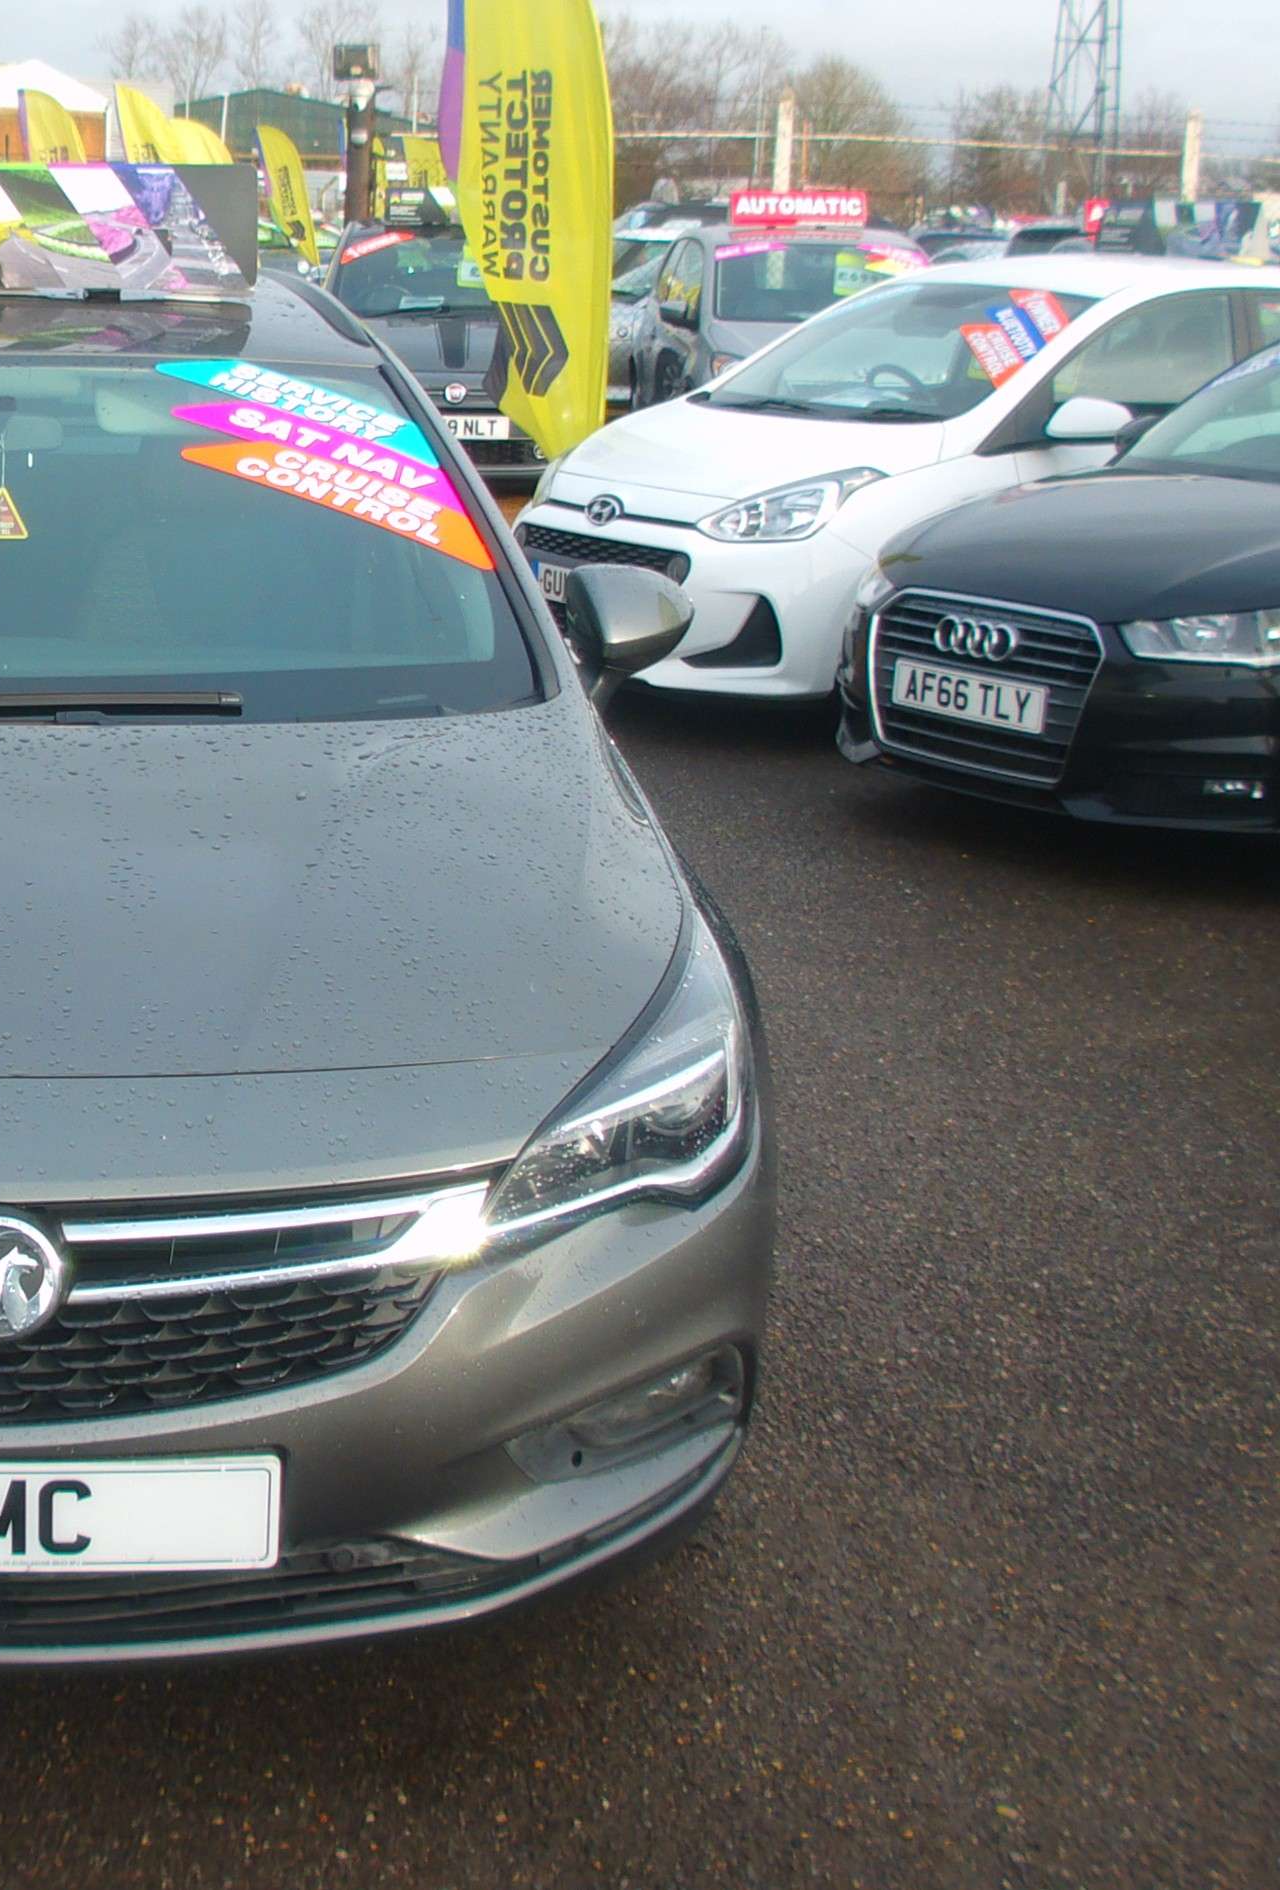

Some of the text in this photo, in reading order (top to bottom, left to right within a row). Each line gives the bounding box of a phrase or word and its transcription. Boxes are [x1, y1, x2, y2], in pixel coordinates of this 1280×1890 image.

[736, 197, 862, 216] AUTOMATIC
[208, 371, 400, 441] HISTORY
[230, 363, 407, 429] SERVICE
[463, 419, 498, 436] NLT
[228, 407, 438, 489] SAT NAV
[235, 457, 441, 545] CONTROL
[274, 450, 442, 521] CRUISE
[542, 568, 569, 597] GU
[904, 669, 1032, 723] AF66 TLY
